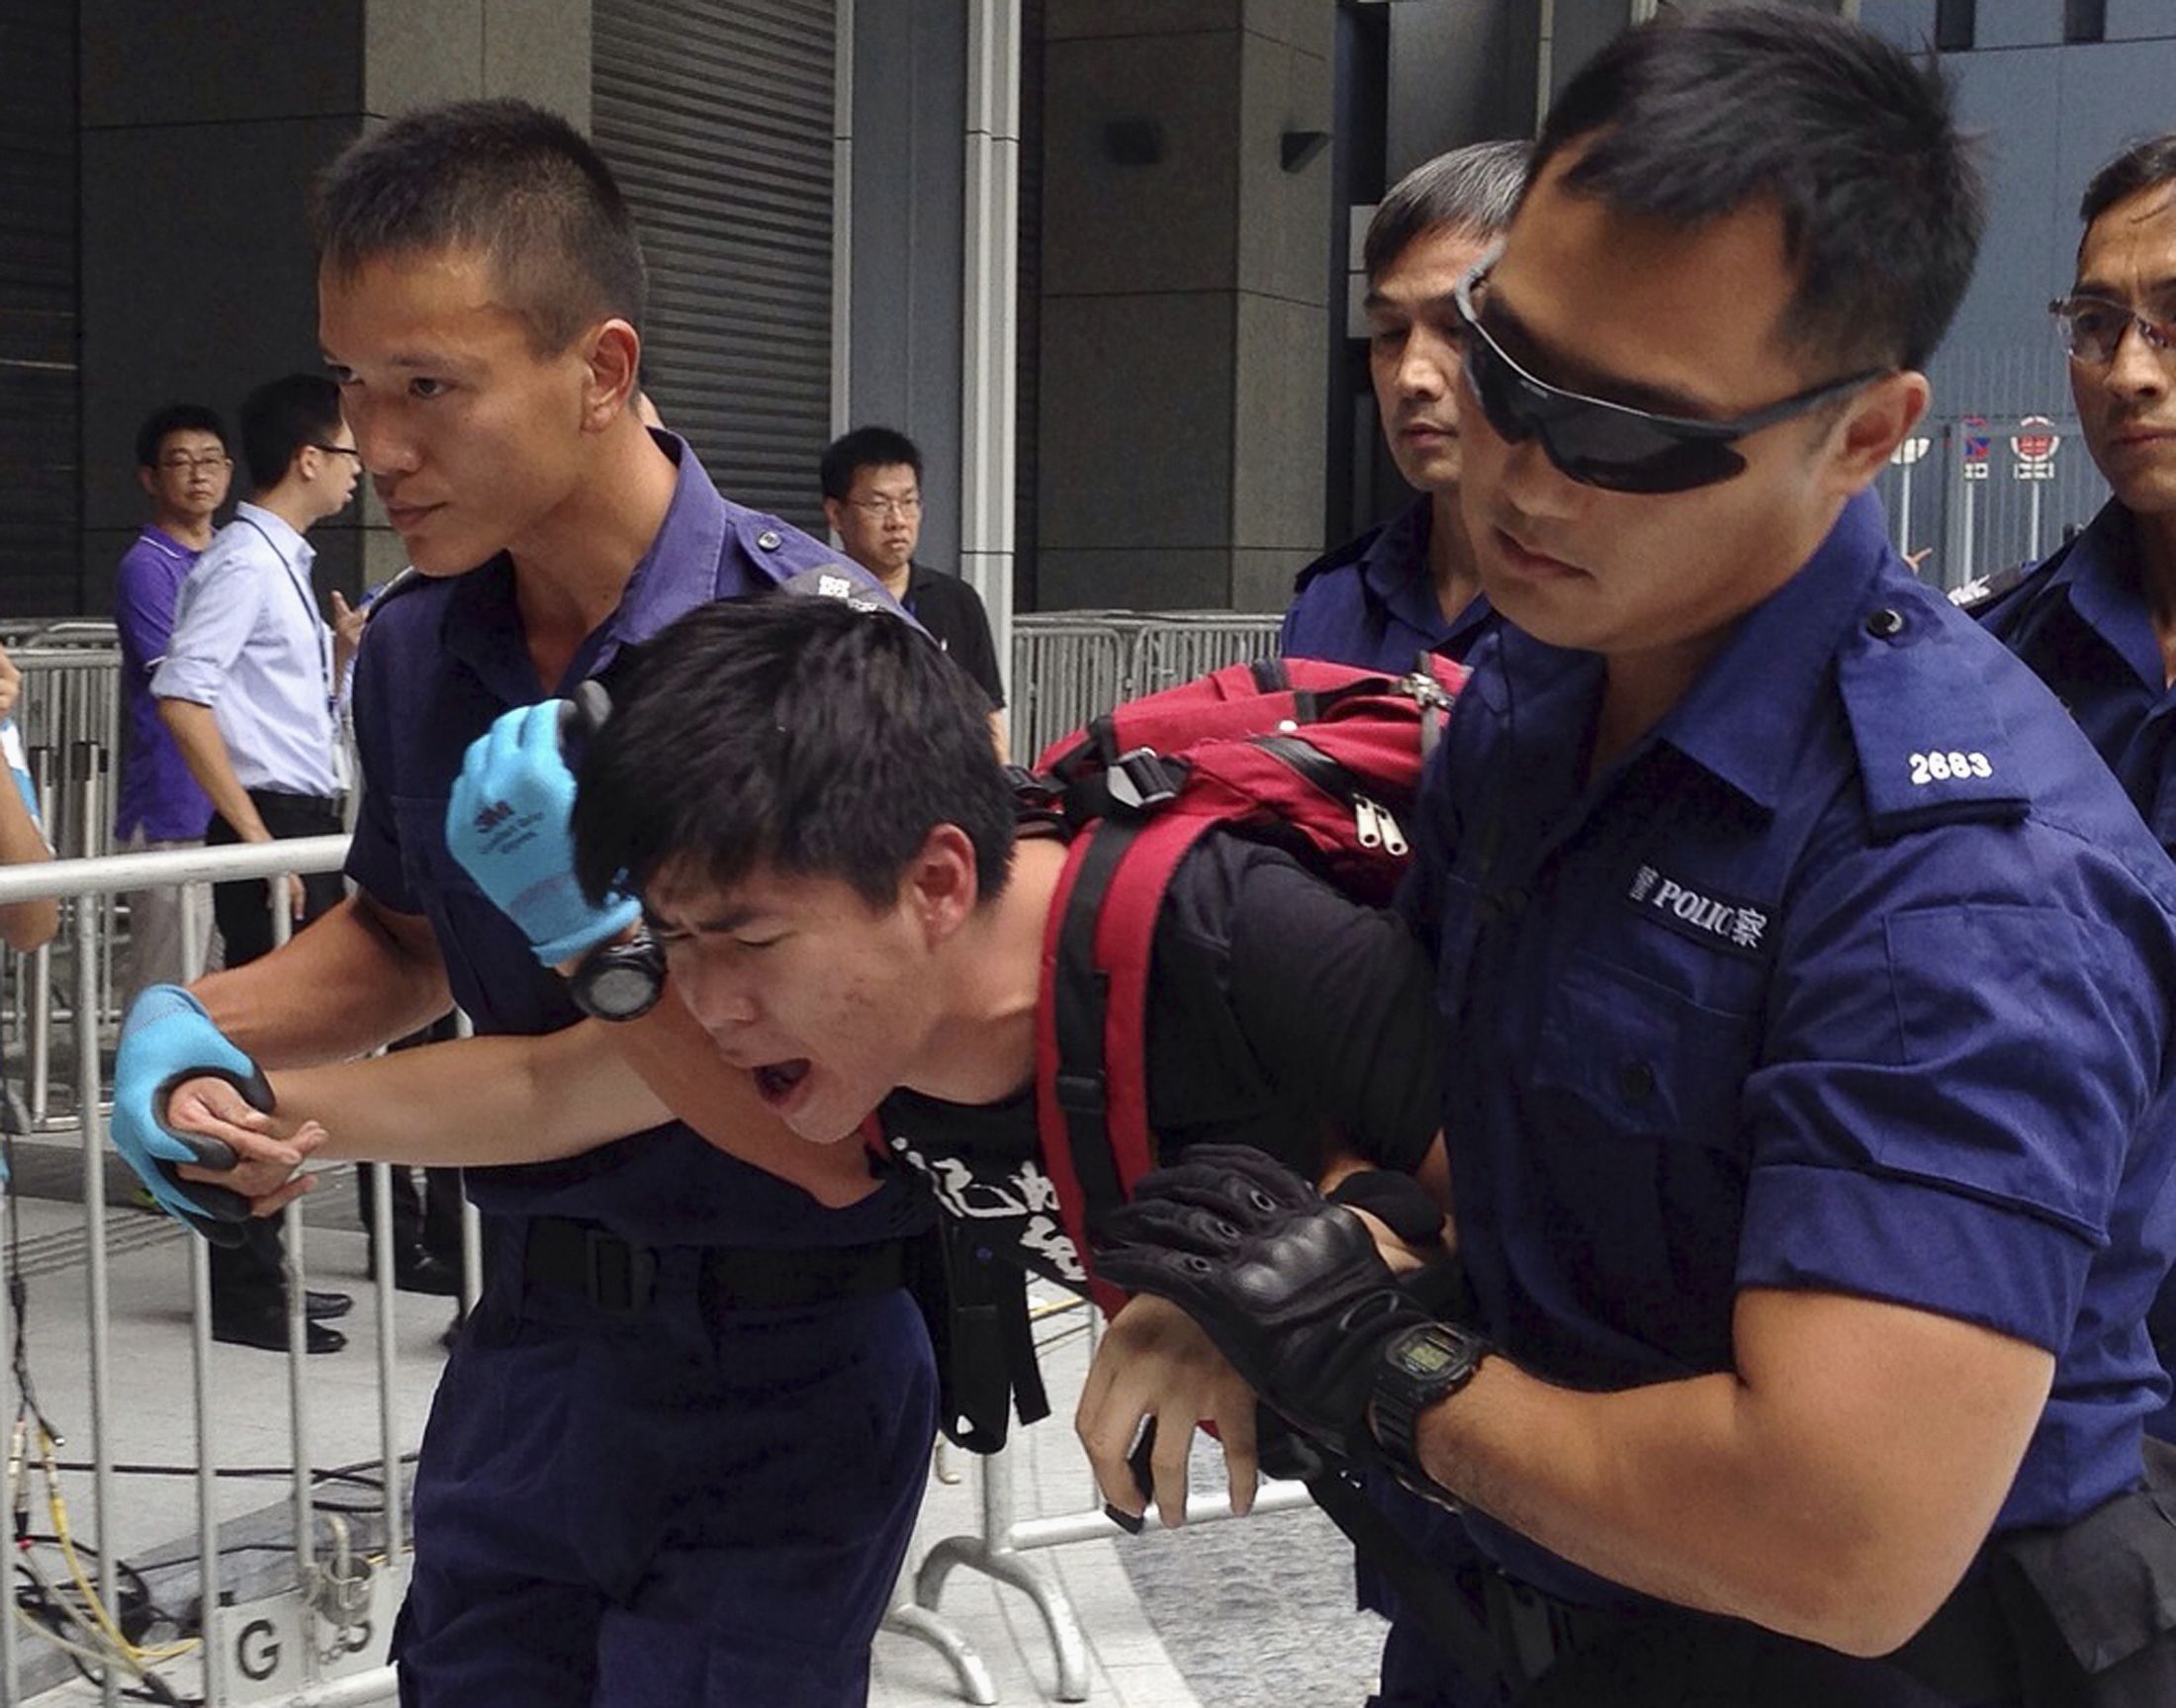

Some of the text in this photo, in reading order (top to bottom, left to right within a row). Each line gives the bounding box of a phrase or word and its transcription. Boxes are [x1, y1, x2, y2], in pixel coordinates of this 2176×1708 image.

[1908, 751, 1993, 785] 2683
[1653, 878, 1734, 936] POLIC
[1732, 908, 1768, 947] 察
[236, 1619, 282, 1680] G
